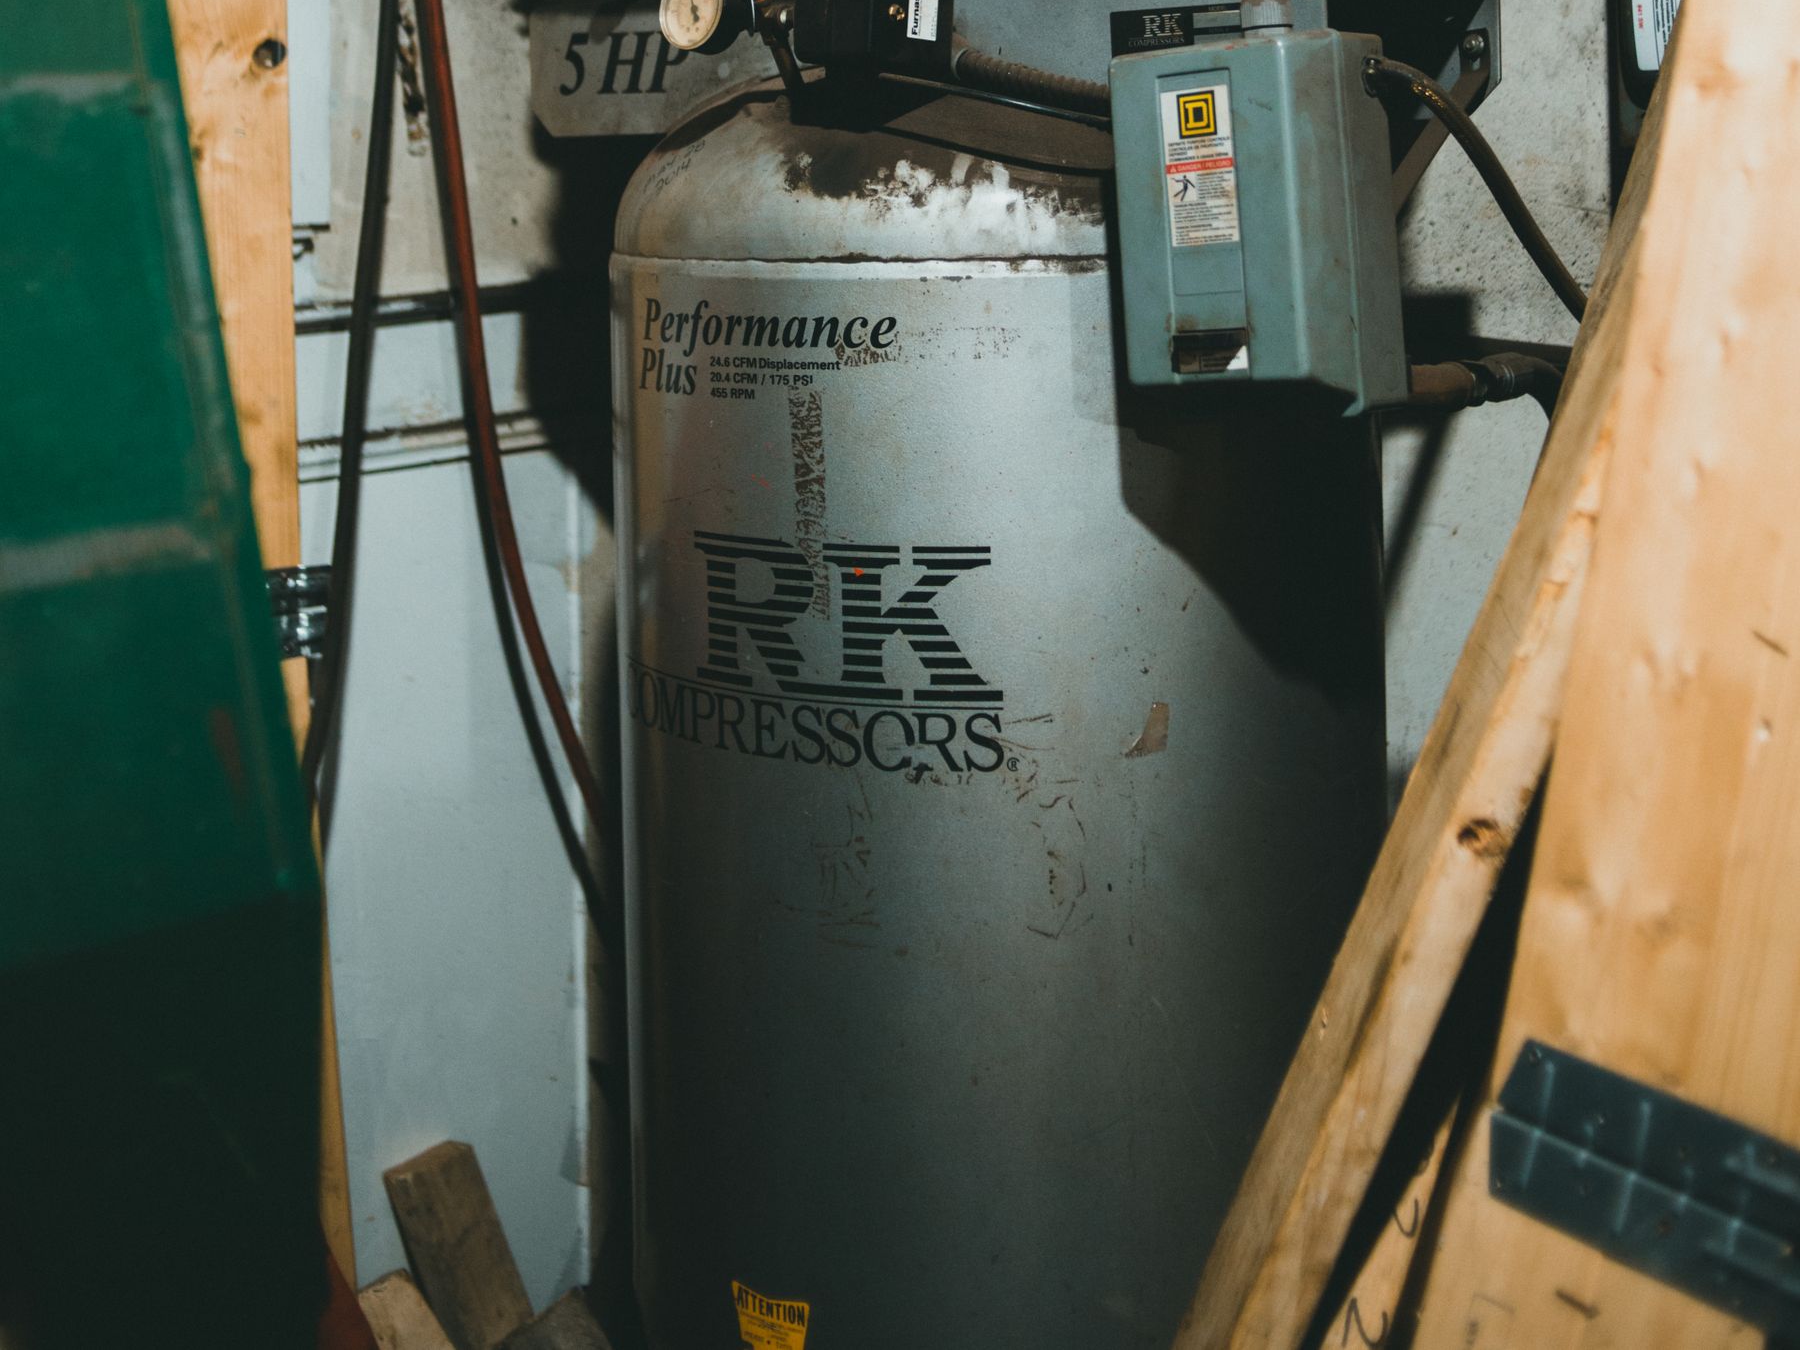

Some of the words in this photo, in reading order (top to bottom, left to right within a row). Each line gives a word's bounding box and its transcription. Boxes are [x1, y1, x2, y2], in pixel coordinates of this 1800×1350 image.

[1142, 13, 1184, 38] RK
[559, 32, 590, 97] 5
[597, 31, 690, 95] HP
[643, 298, 897, 358] Performance
[640, 347, 697, 396] Plus
[710, 356, 730, 367] 24.6
[732, 357, 757, 369] CFM
[758, 358, 841, 372] Displacement
[710, 371, 731, 383] 20.4
[733, 373, 757, 384] CFM
[760, 374, 766, 386] /
[769, 374, 789, 386] 175
[793, 374, 813, 387] PSI
[710, 387, 728, 399] 455
[730, 388, 755, 400] RPM
[694, 530, 1004, 701] RK
[737, 1286, 806, 1328] ATTENTION
